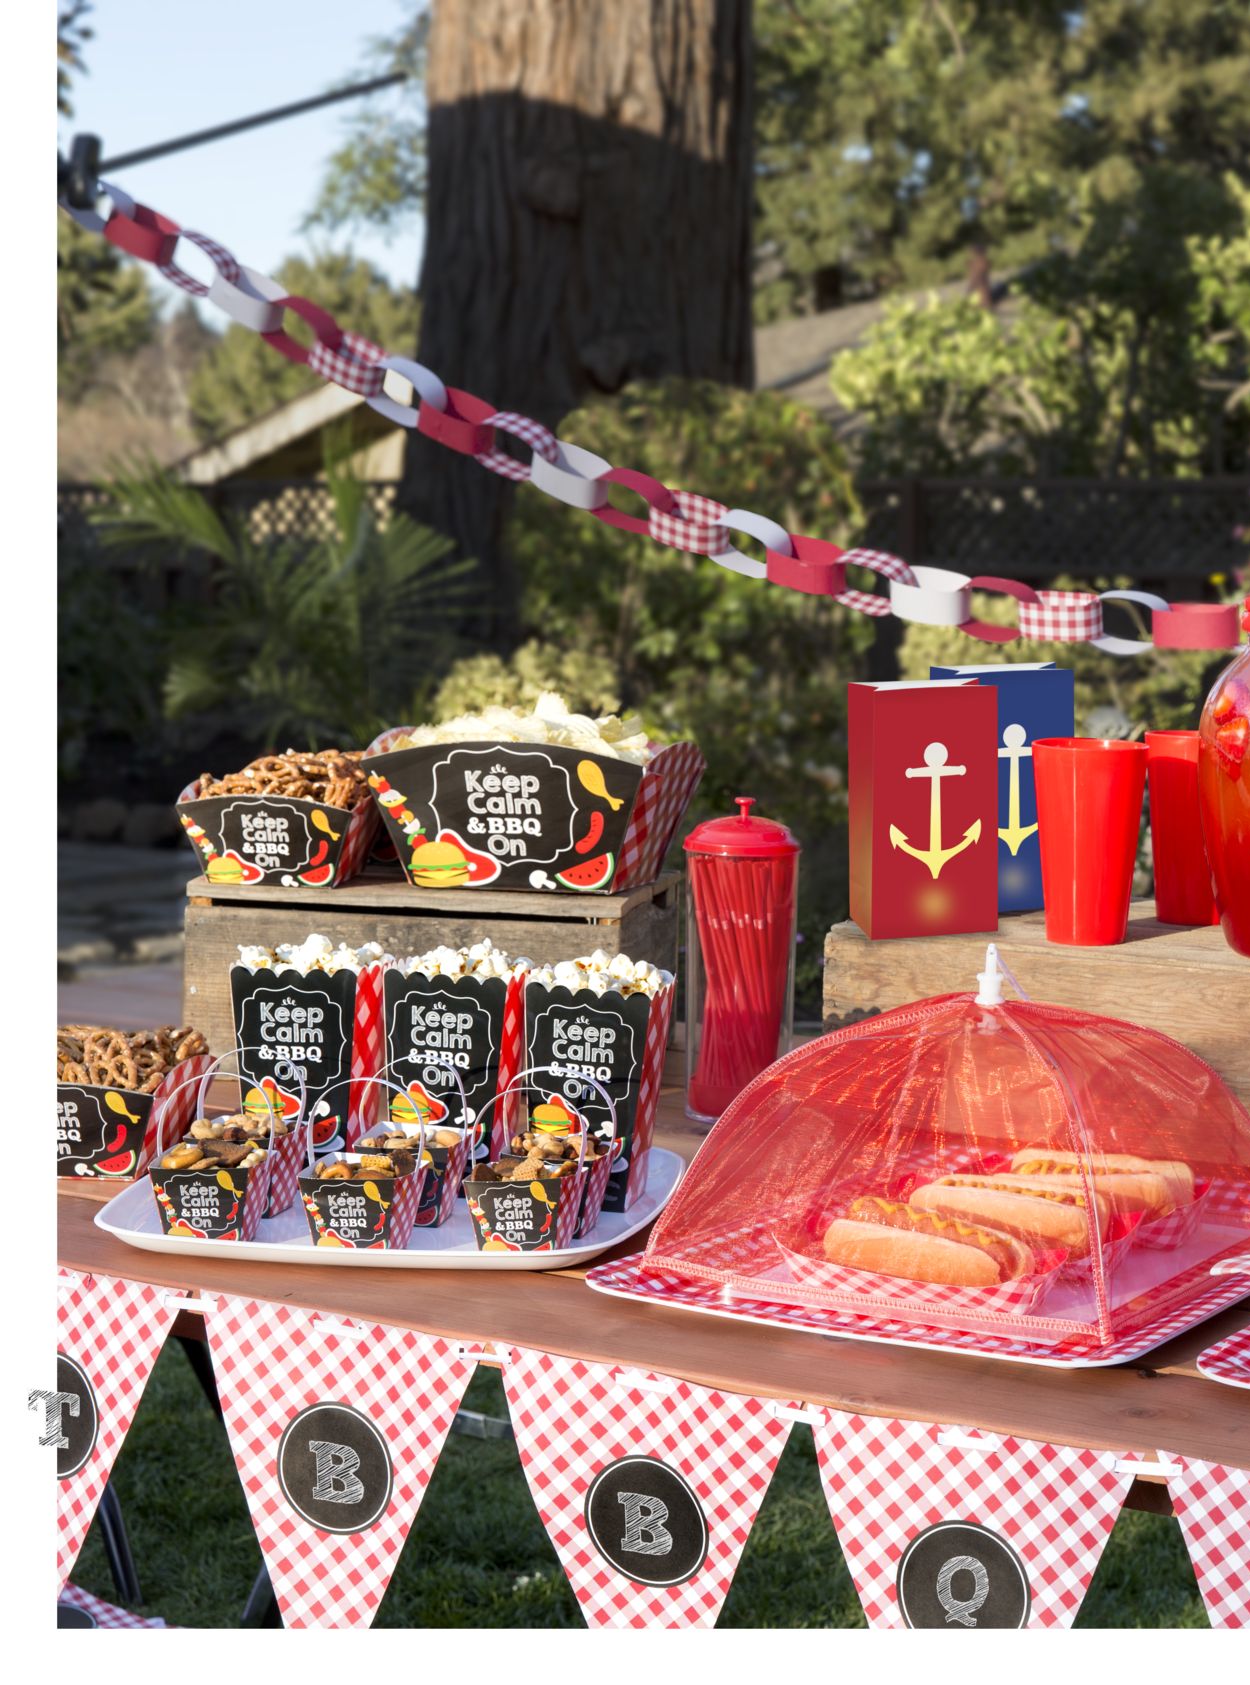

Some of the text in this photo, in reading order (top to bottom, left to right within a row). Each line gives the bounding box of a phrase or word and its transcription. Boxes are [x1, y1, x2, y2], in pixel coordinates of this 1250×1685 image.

[464, 770, 540, 798] Keep
[467, 792, 542, 815] Calm
[241, 814, 289, 832] Keep
[242, 828, 290, 843] Calm
[487, 834, 527, 856] On
[255, 853, 280, 867] On
[260, 1001, 324, 1028] Keep
[411, 1005, 473, 1033] Keep
[260, 1022, 324, 1043] Calm
[411, 1026, 472, 1050] Calm
[553, 1018, 616, 1048] Keep
[552, 1039, 614, 1064] Calm
[274, 1061, 308, 1081] On
[422, 1065, 455, 1087] On
[563, 1079, 596, 1101] On
[179, 1185, 219, 1198] Keep
[181, 1195, 220, 1207] Calm
[328, 1195, 366, 1209] Keep
[329, 1205, 367, 1217] Calm
[494, 1197, 532, 1210] Keep
[191, 1217, 212, 1228] On
[495, 1208, 534, 1220] Calm
[340, 1228, 360, 1238] On
[506, 1230, 526, 1241] On
[28, 1390, 989, 1628] T B B Q
